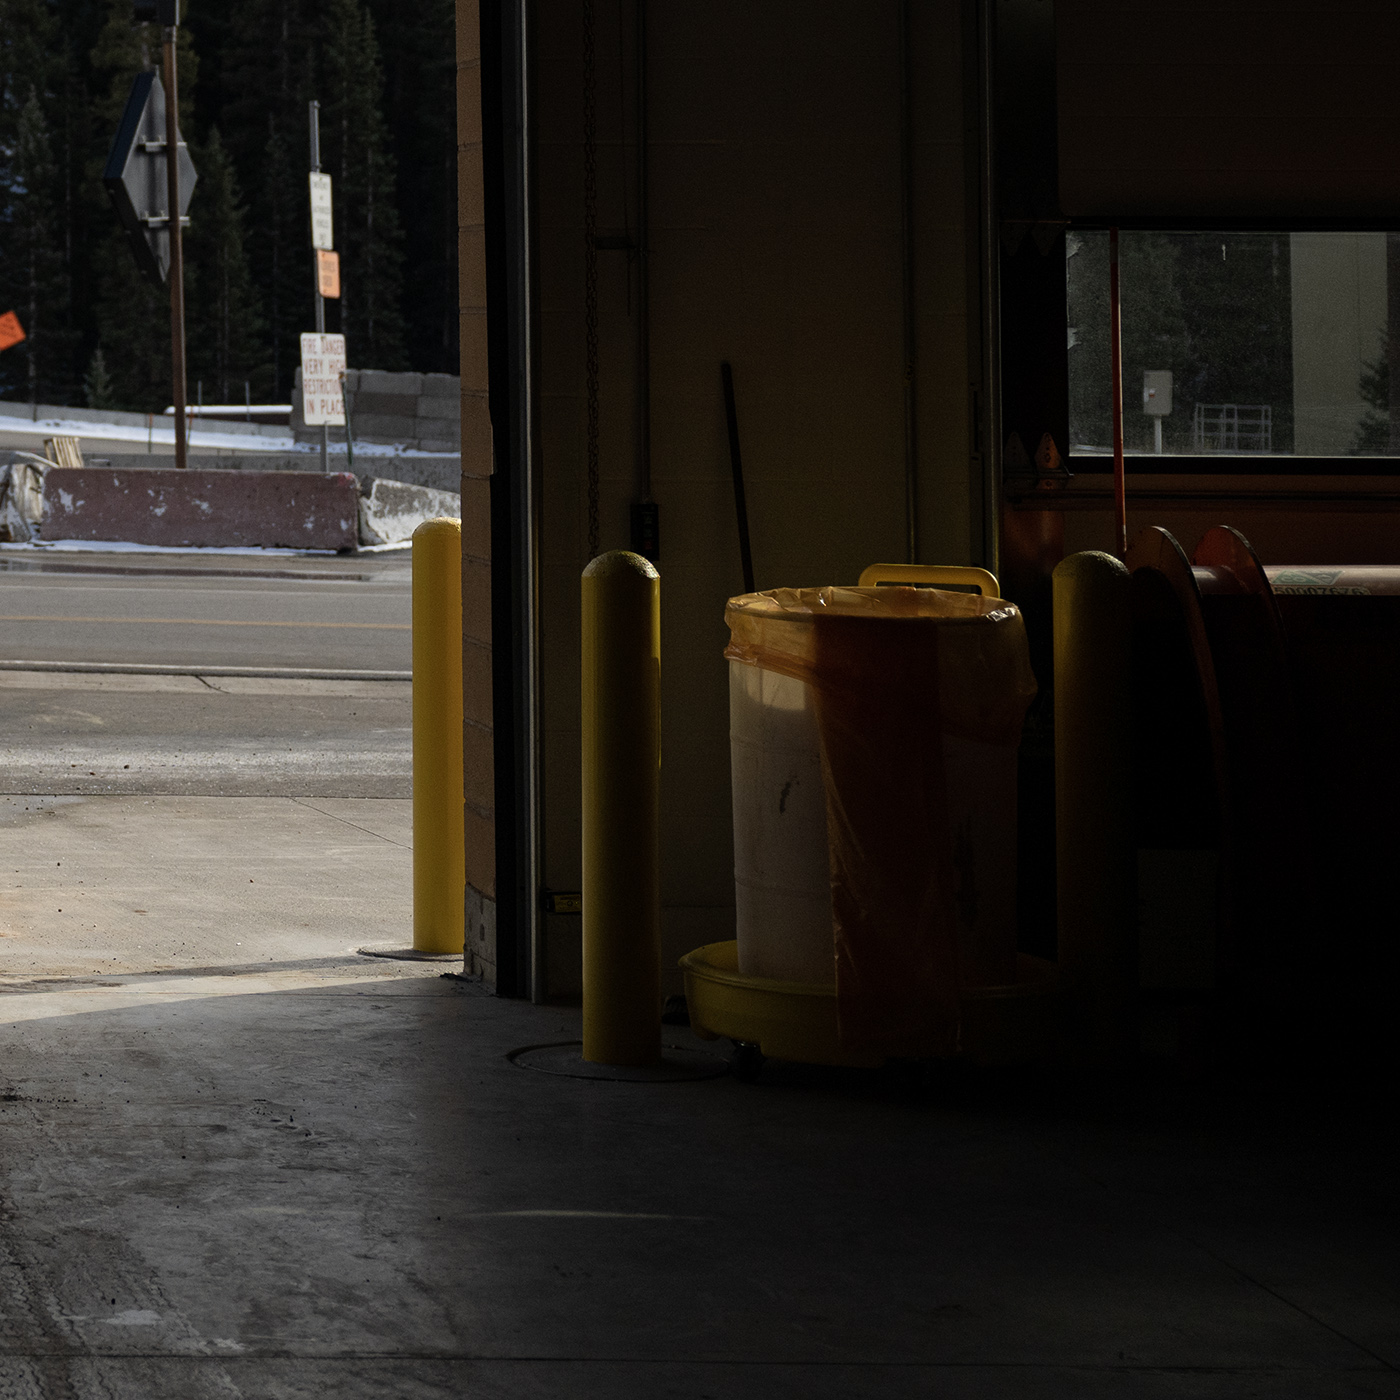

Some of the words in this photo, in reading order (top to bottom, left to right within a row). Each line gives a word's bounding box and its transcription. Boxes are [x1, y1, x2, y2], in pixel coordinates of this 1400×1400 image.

[303, 337, 318, 355] FIRE
[320, 337, 345, 356] DANGER
[304, 358, 323, 375] VERY
[328, 358, 346, 375] HIGH
[306, 398, 315, 415] IN
